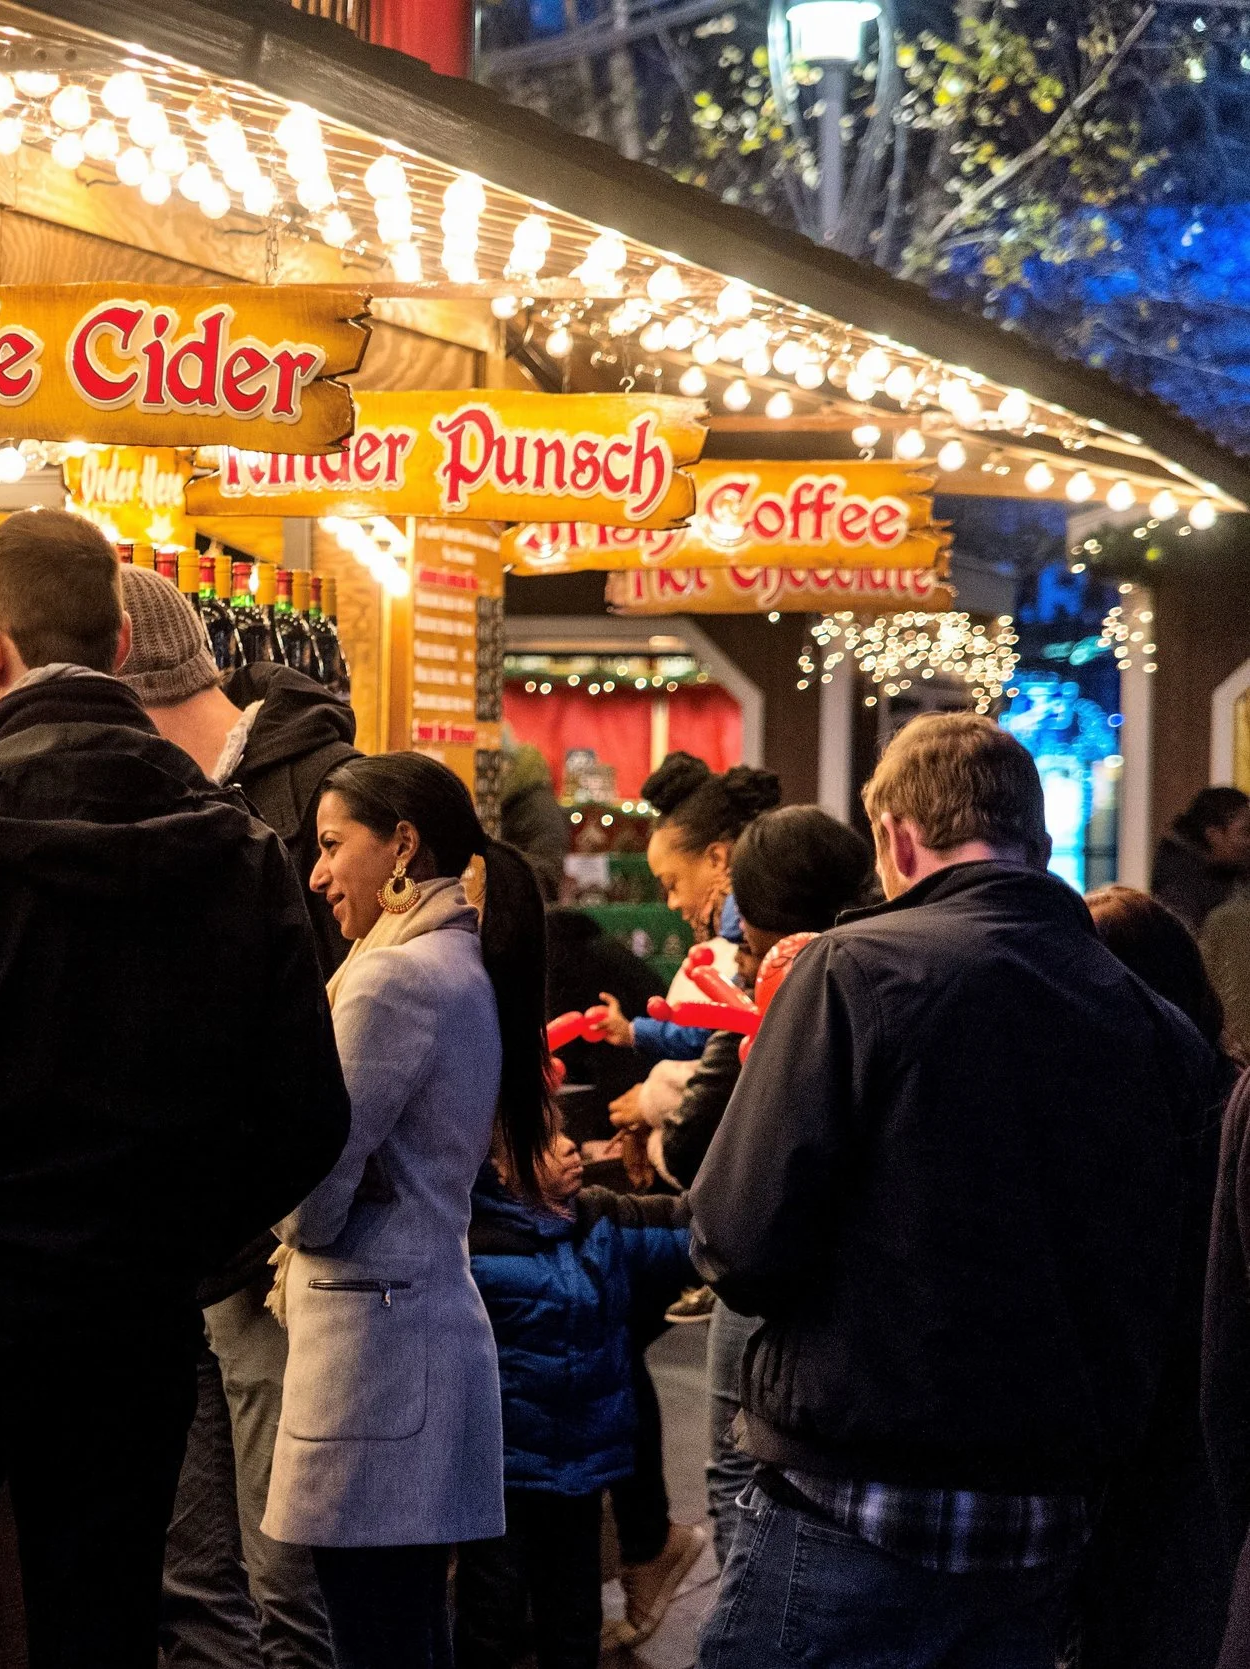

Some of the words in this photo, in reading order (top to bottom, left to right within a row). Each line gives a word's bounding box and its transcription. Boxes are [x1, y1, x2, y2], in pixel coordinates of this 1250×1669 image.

[66, 299, 327, 424] Cider
[432, 403, 671, 521] Punsch
[695, 473, 912, 552] Coffee
